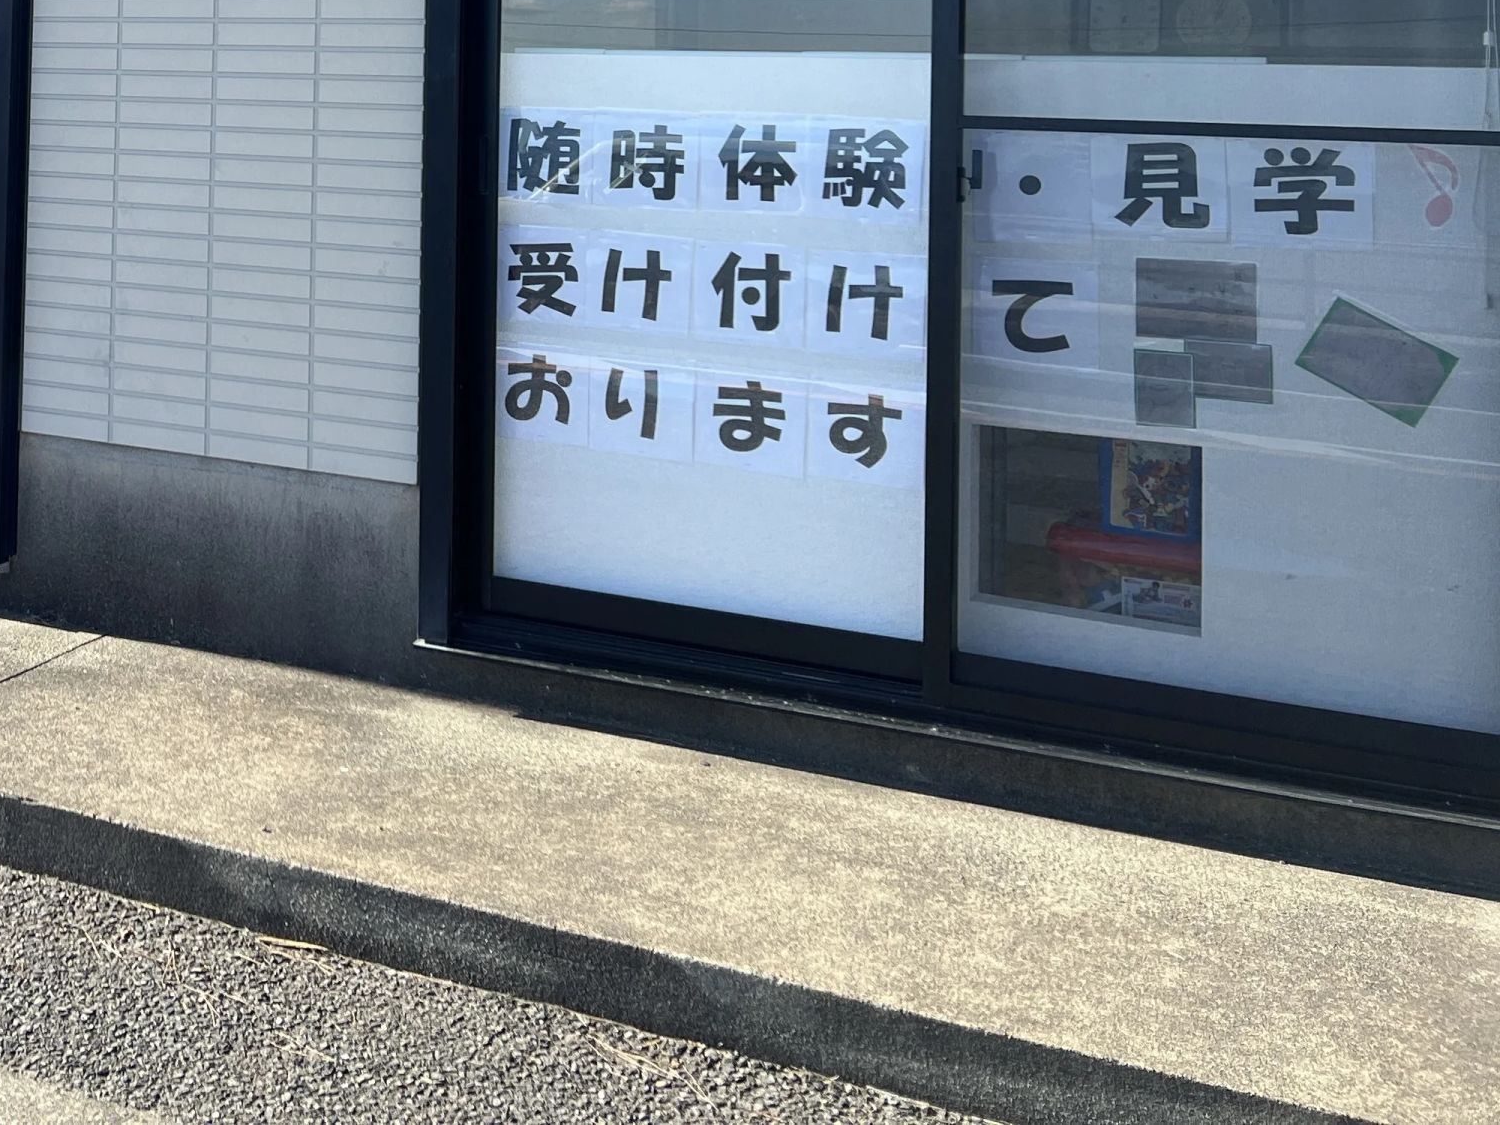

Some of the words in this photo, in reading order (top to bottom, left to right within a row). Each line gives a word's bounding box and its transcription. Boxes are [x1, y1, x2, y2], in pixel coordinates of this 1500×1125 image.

[506, 117, 910, 210] 随時体験
[507, 242, 904, 341] 受け付け
[991, 279, 1074, 354] て
[504, 354, 903, 469] おります
